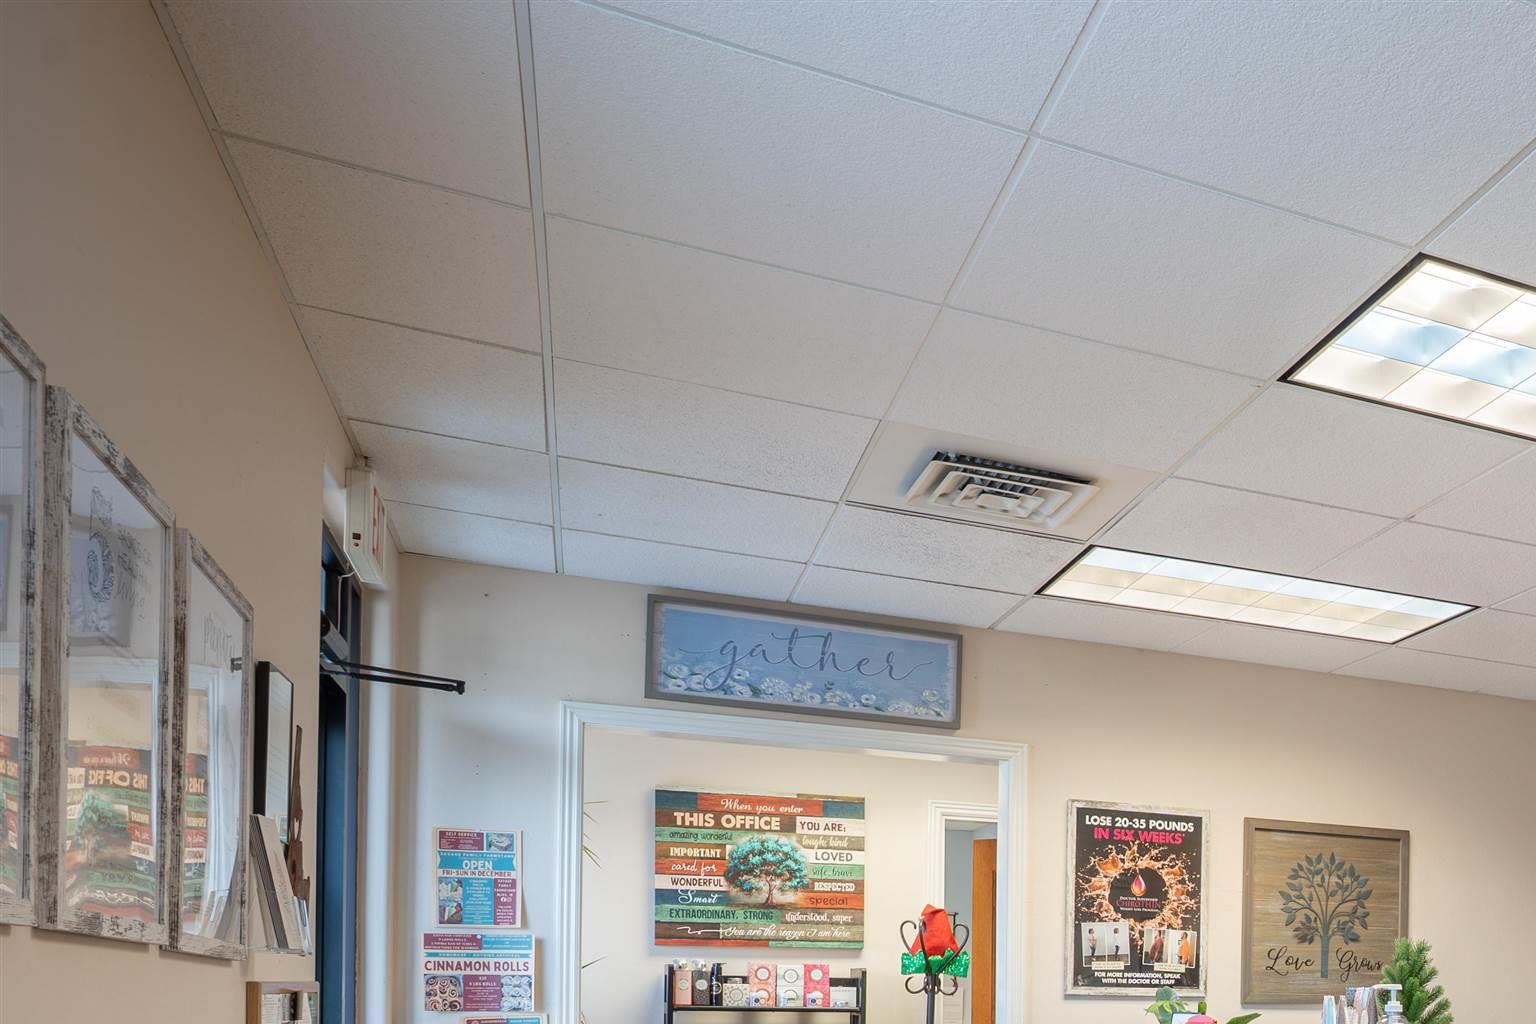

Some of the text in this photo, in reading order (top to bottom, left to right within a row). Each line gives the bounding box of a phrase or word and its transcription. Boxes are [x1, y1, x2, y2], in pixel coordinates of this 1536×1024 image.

[679, 627, 933, 690] gather
[721, 798, 752, 811] When
[755, 804, 774, 815] you
[674, 812, 780, 830] THIS OFFICE
[800, 821, 846, 833] YOU ARE:
[1085, 816, 1194, 832] LOSE 20-35 POUNDS
[1094, 827, 1109, 840] IN
[1114, 829, 1134, 841] SIX
[670, 847, 720, 857] IMPORTANT
[815, 852, 853, 862] LOVED
[463, 861, 493, 869] OPEN
[672, 860, 717, 877] cared for
[671, 878, 723, 887] WONDERFUL
[678, 889, 723, 904] Smart
[809, 895, 848, 906] special
[669, 909, 773, 920] EXTRAORDINARY, STRONG
[424, 960, 529, 972] CINNAMON ROLLS
[1265, 946, 1383, 982] Love Grows
